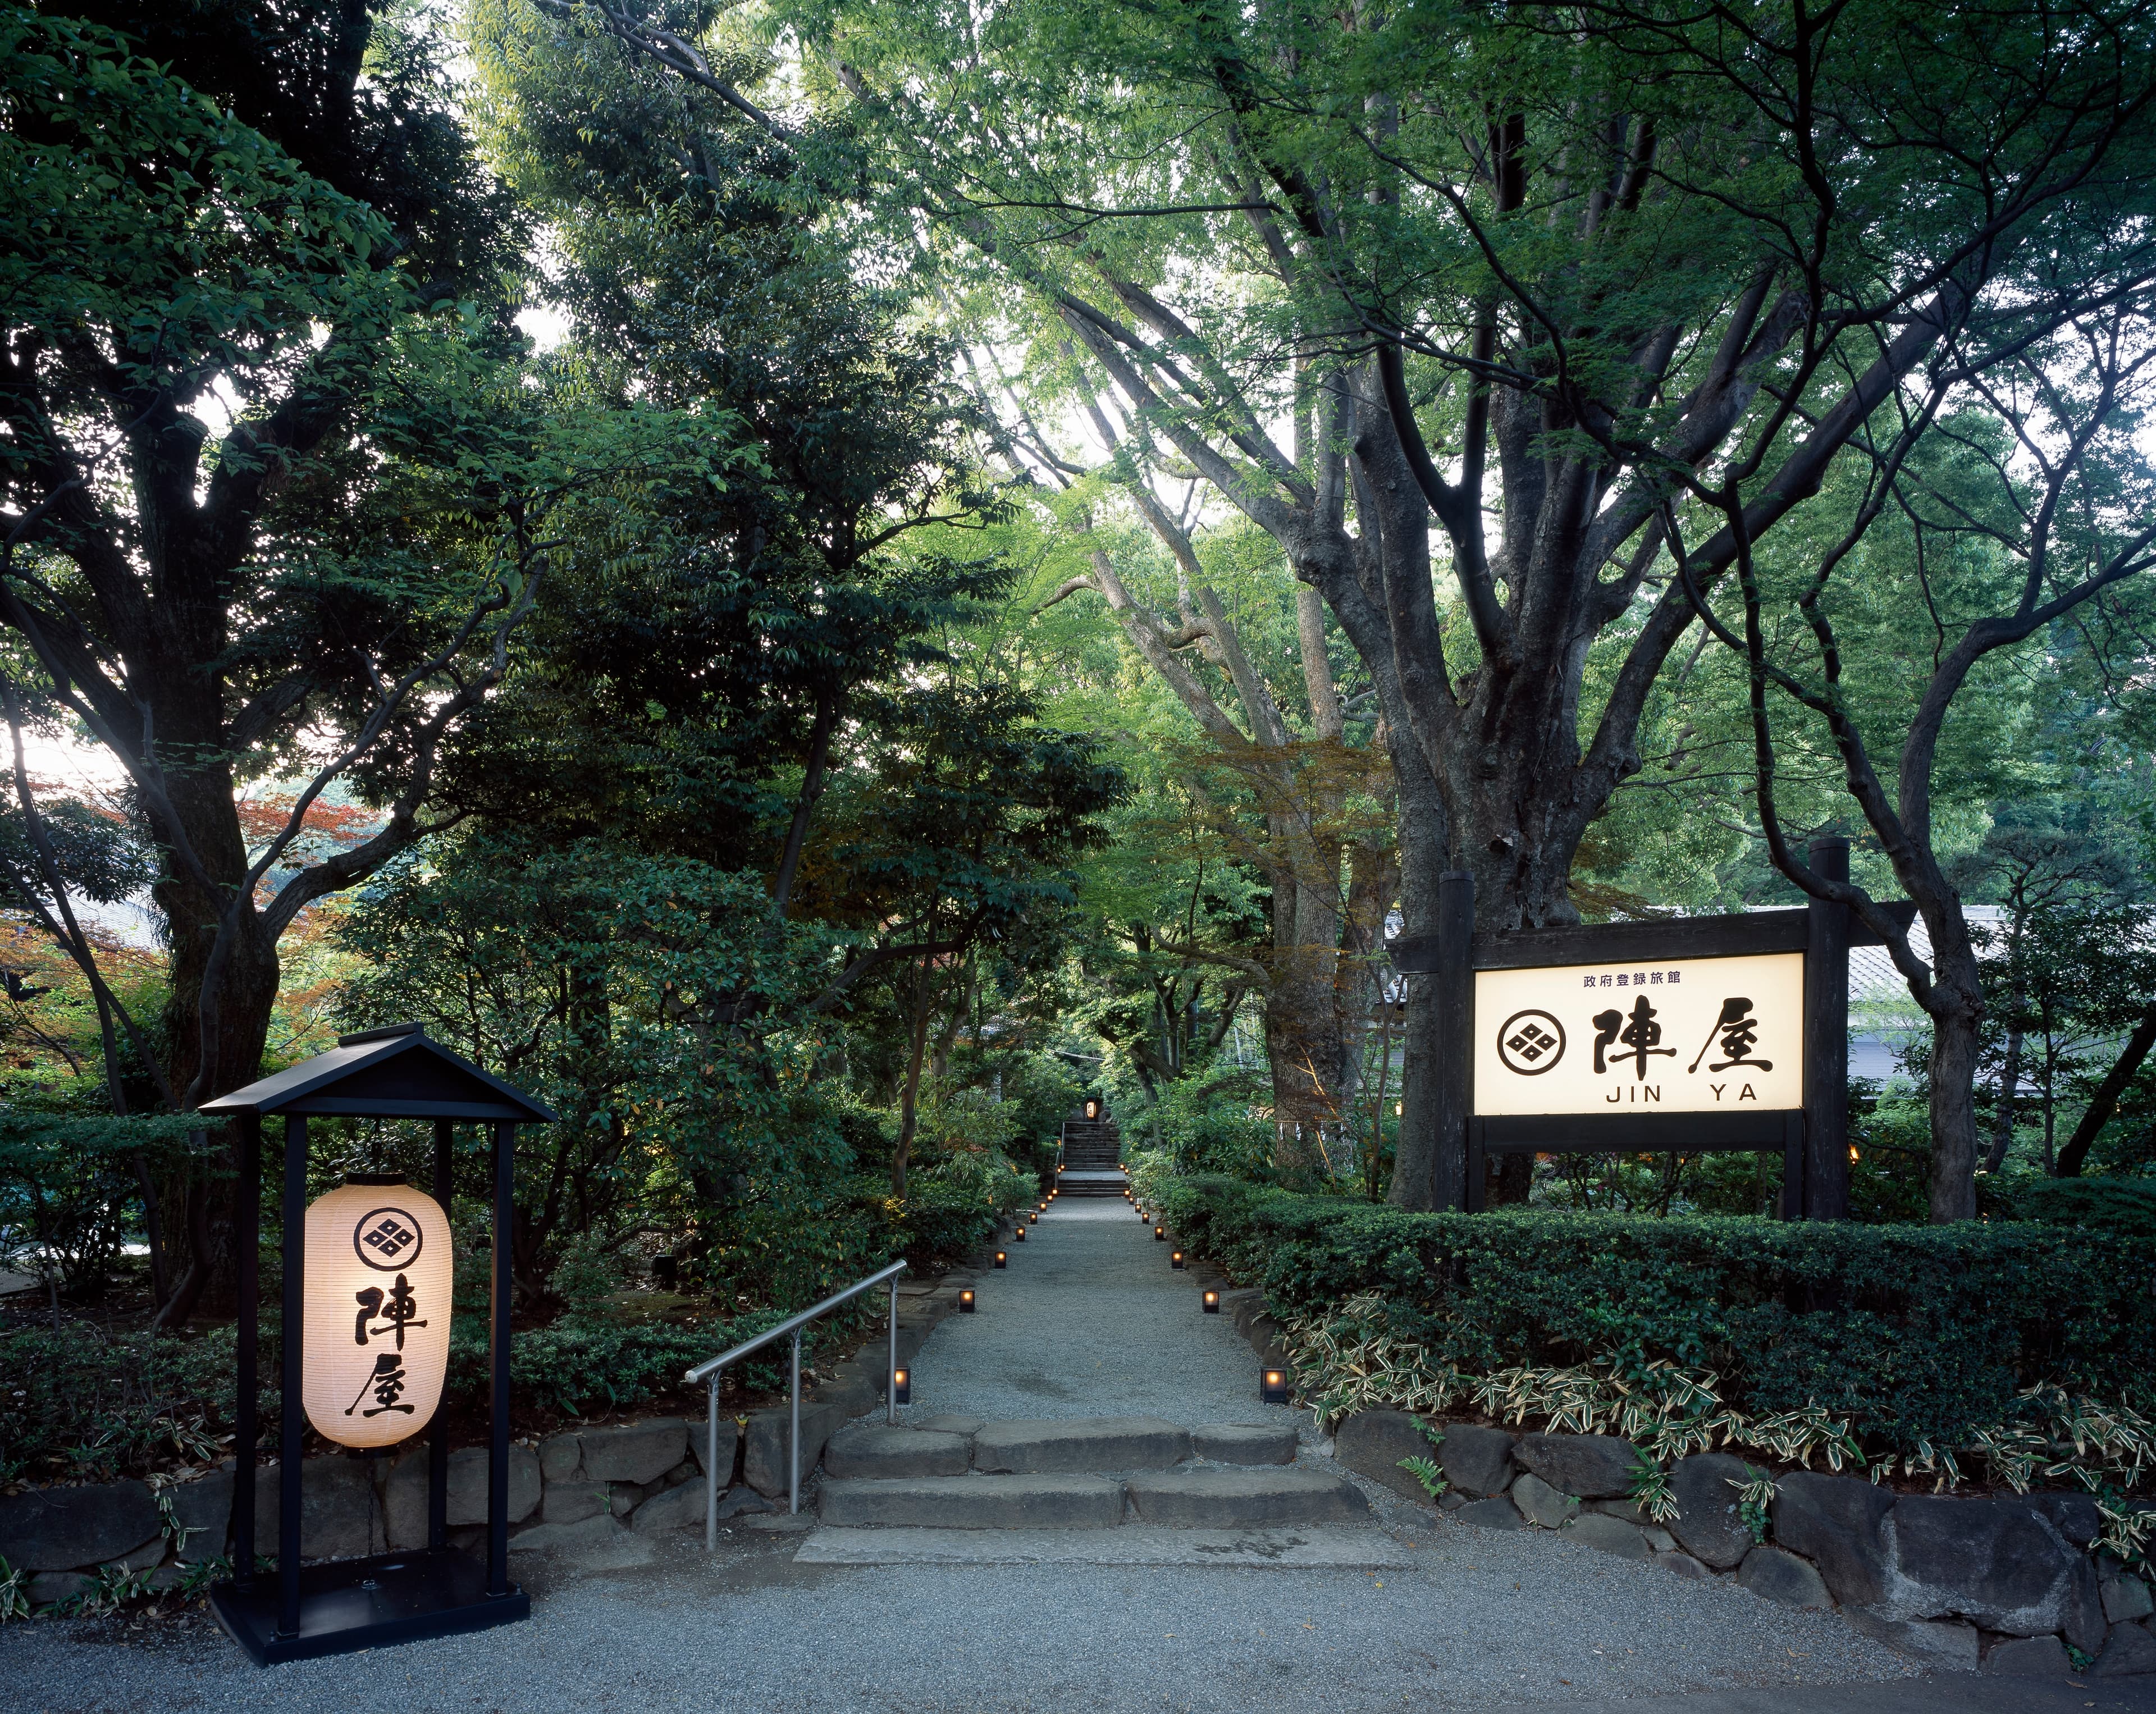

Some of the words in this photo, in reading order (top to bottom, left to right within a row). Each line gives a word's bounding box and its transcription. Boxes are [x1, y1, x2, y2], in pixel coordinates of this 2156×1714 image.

[1583, 971, 1680, 988] 政府登録旅館
[1592, 995, 1773, 1081] 陣屋
[1606, 1085, 1661, 1103] JIN
[1710, 1084, 1757, 1101] YA
[344, 1273, 428, 1418] 陣屋
